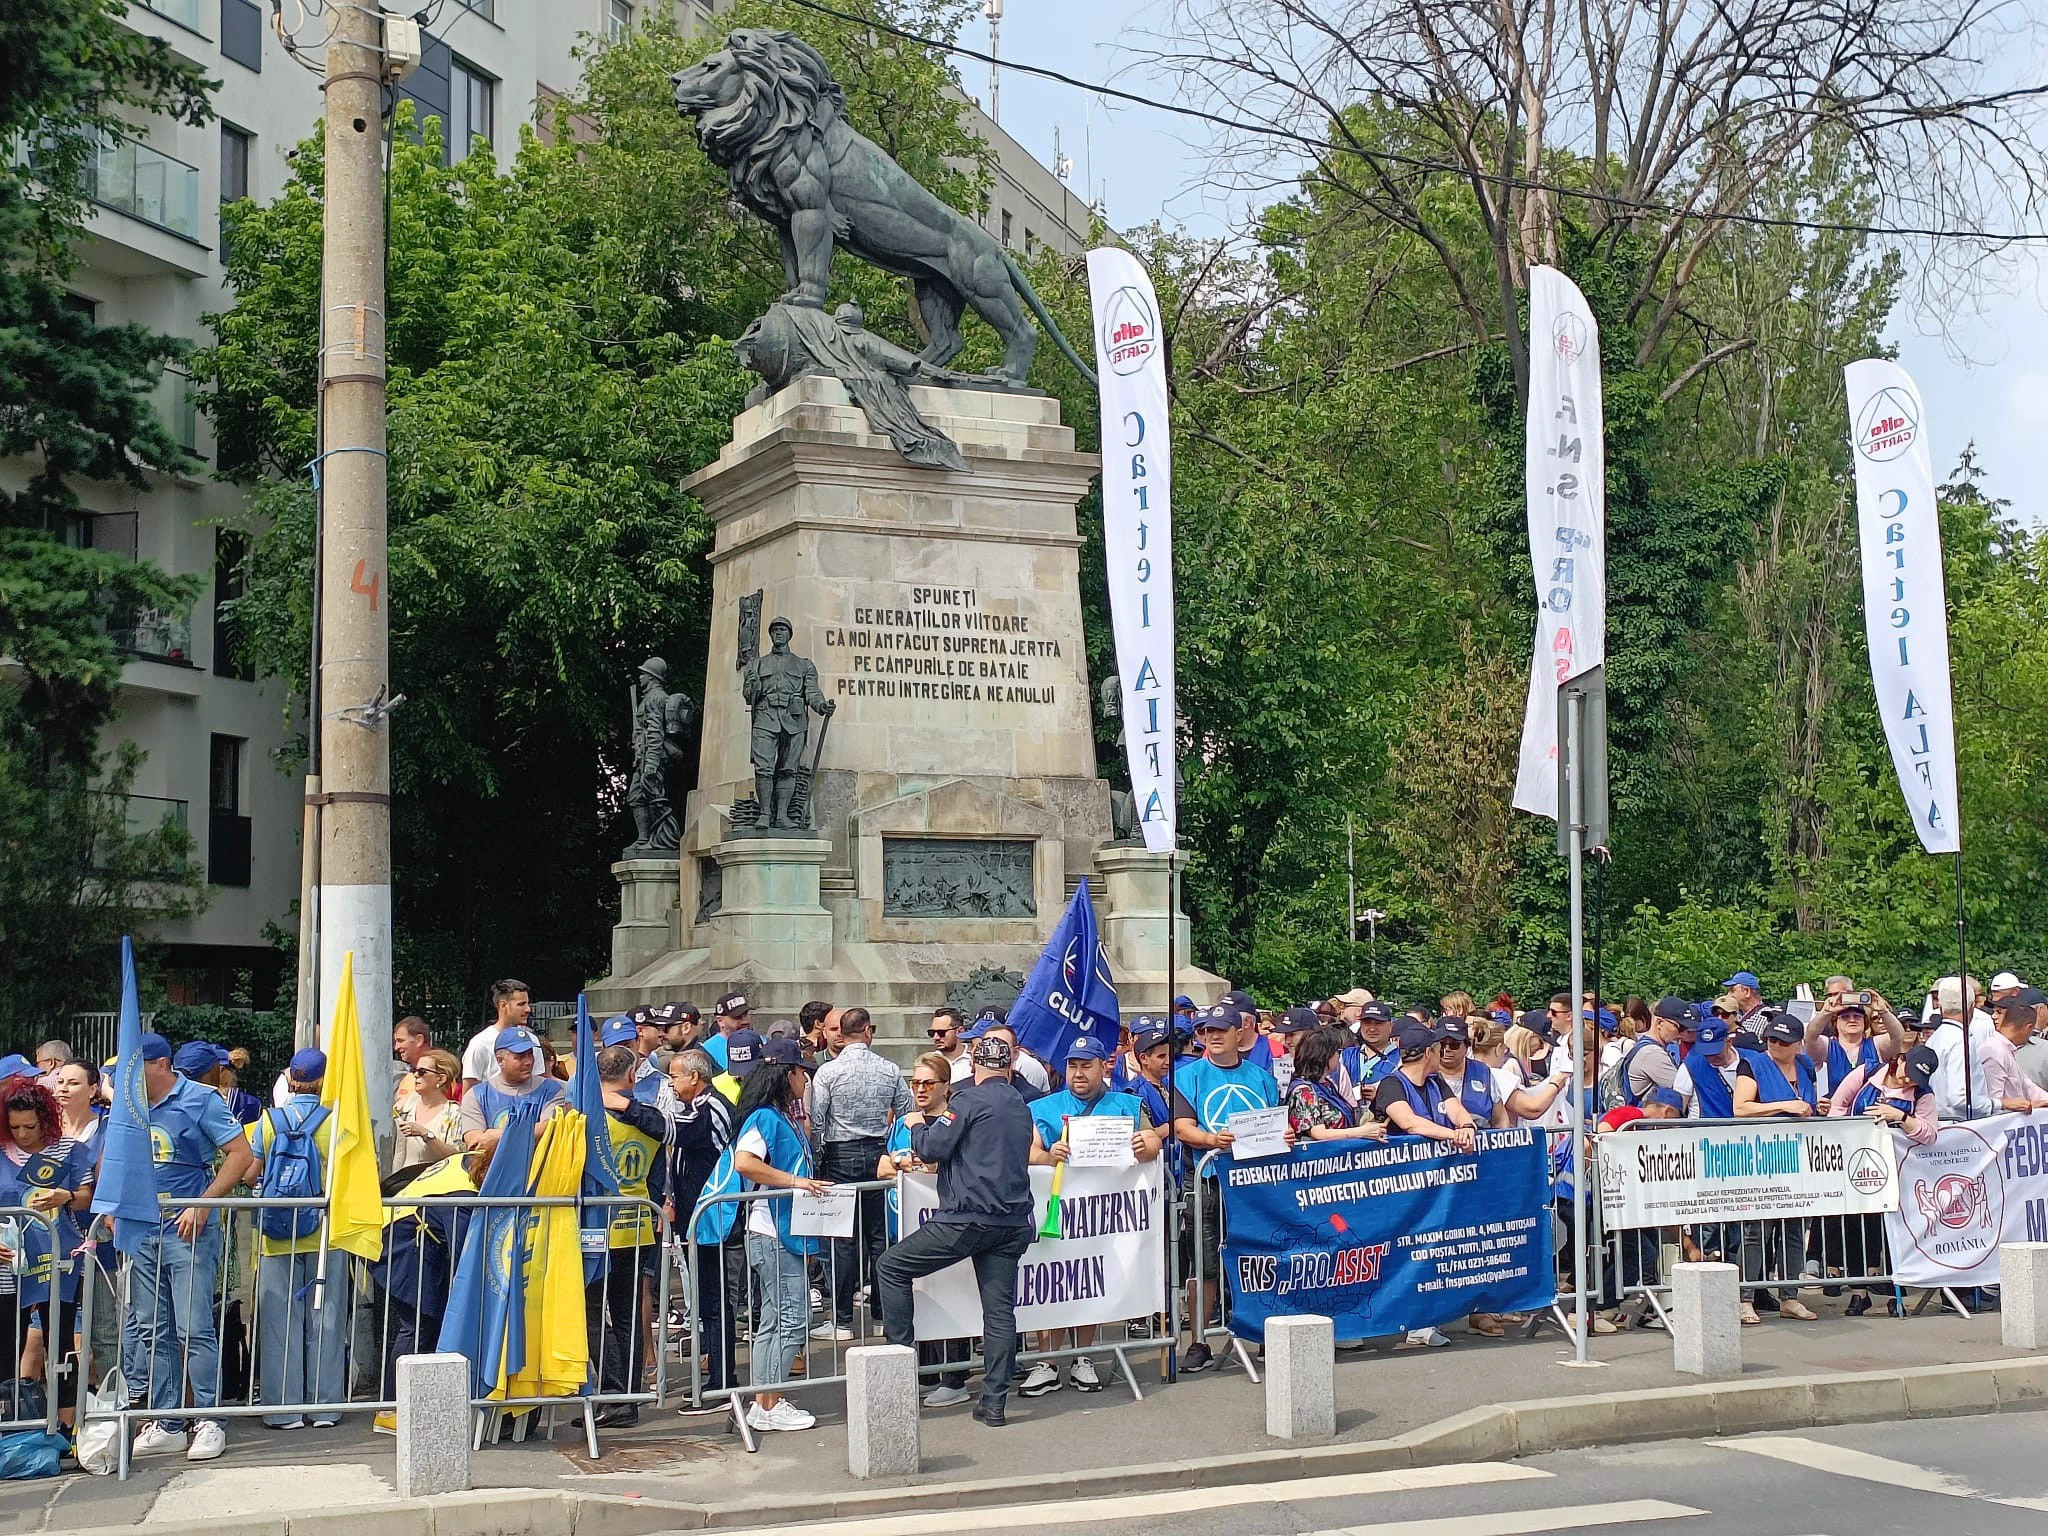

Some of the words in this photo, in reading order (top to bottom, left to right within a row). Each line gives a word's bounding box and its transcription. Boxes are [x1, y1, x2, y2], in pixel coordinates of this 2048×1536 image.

[351, 558, 379, 612] 4
[964, 612, 1029, 633] VIITOARE
[849, 630, 871, 648] NOI
[875, 632, 893, 649] AM
[943, 636, 1007, 655] SUPREMA
[854, 655, 871, 672] PE
[959, 660, 975, 677] DE
[837, 678, 895, 697] PENTRU
[987, 685, 1055, 704] NEAMULUI
[1048, 991, 1095, 1031] CLUJ
[1412, 1142, 1432, 1161] DIN
[1637, 1141, 1696, 1183] Sindicatul
[1805, 1135, 1844, 1173] Valcea
[1369, 1173, 1426, 1197] COPILULUI
[1425, 1163, 1478, 1187] PRO.ASIST
[1857, 1167, 1879, 1178] alfa
[1397, 1235, 1414, 1248] STR.
[1415, 1231, 1443, 1245] MAXIM
[1411, 1250, 1428, 1261] COD
[1436, 1259, 1468, 1274] TEL/FAX
[1238, 1255, 1277, 1293] FNS
[1417, 1279, 1444, 1292] e-mail:
